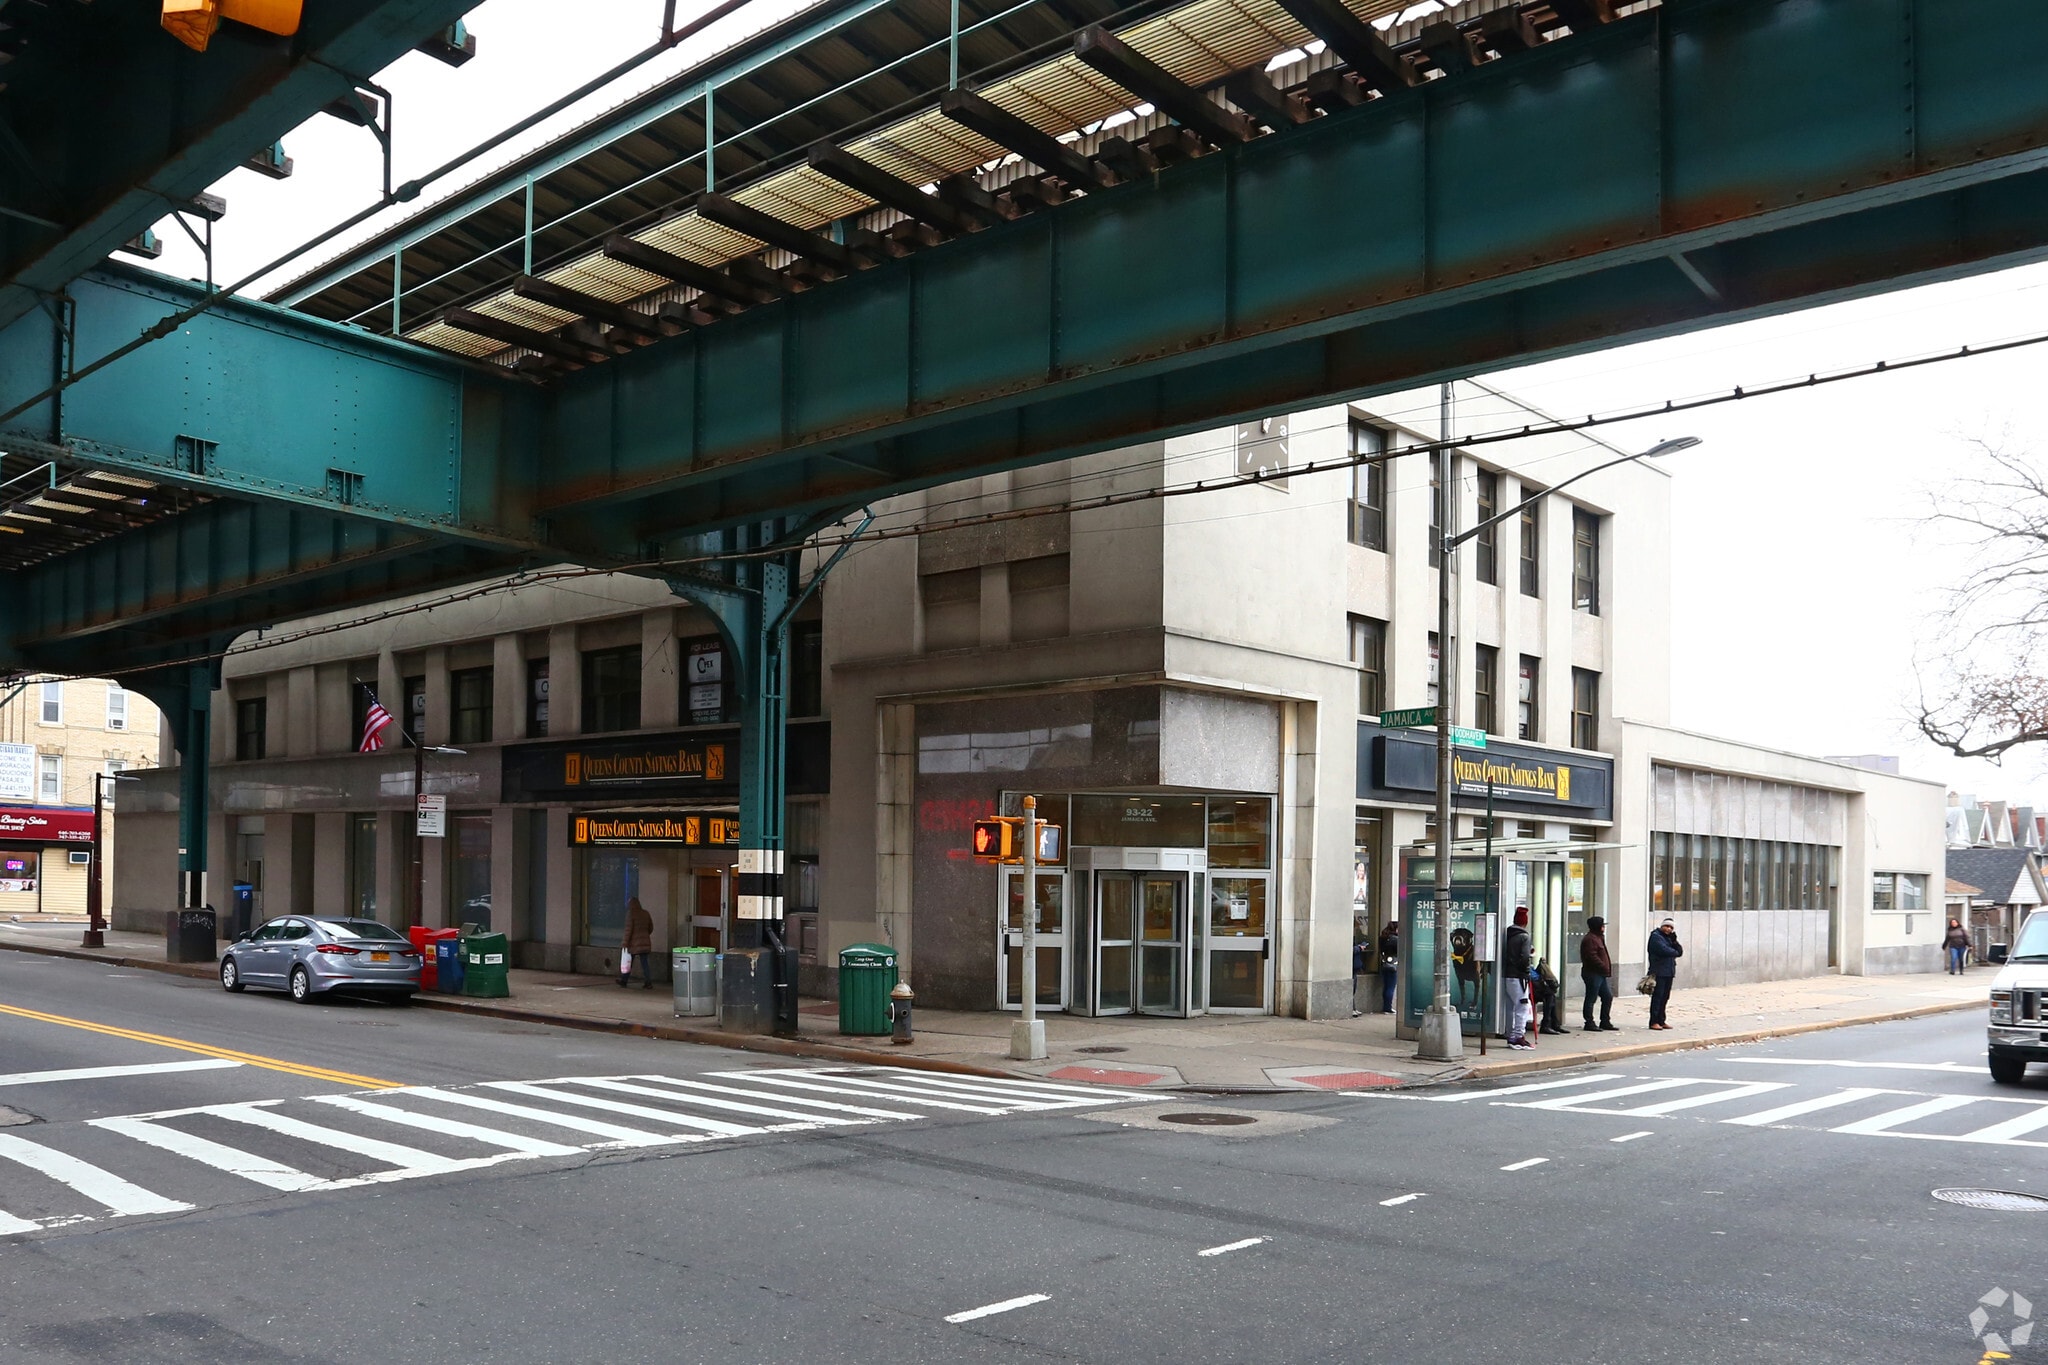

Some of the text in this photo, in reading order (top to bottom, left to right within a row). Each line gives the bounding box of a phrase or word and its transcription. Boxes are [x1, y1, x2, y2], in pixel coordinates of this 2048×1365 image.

[1382, 711, 1422, 728] JAMAICA
[583, 754, 613, 782] QUEENS
[613, 752, 644, 775] COUNTY
[645, 751, 677, 775] SAVINGS
[678, 749, 702, 772] BANK
[1454, 755, 1482, 785] QUEENS
[1482, 759, 1510, 786] COUNTY
[1510, 762, 1537, 788] SAVINGS
[1537, 766, 1556, 790] BANK
[1126, 808, 1153, 817] 93-22
[589, 819, 612, 841] QUEENS
[613, 819, 638, 837] COUNTY
[638, 818, 664, 838] SAVINGS
[664, 819, 683, 838] BANK
[242, 891, 249, 899] P
[1462, 902, 1481, 910] PET
[1416, 910, 1423, 919] &
[1450, 911, 1464, 920] OF
[1416, 920, 1435, 929] THE
